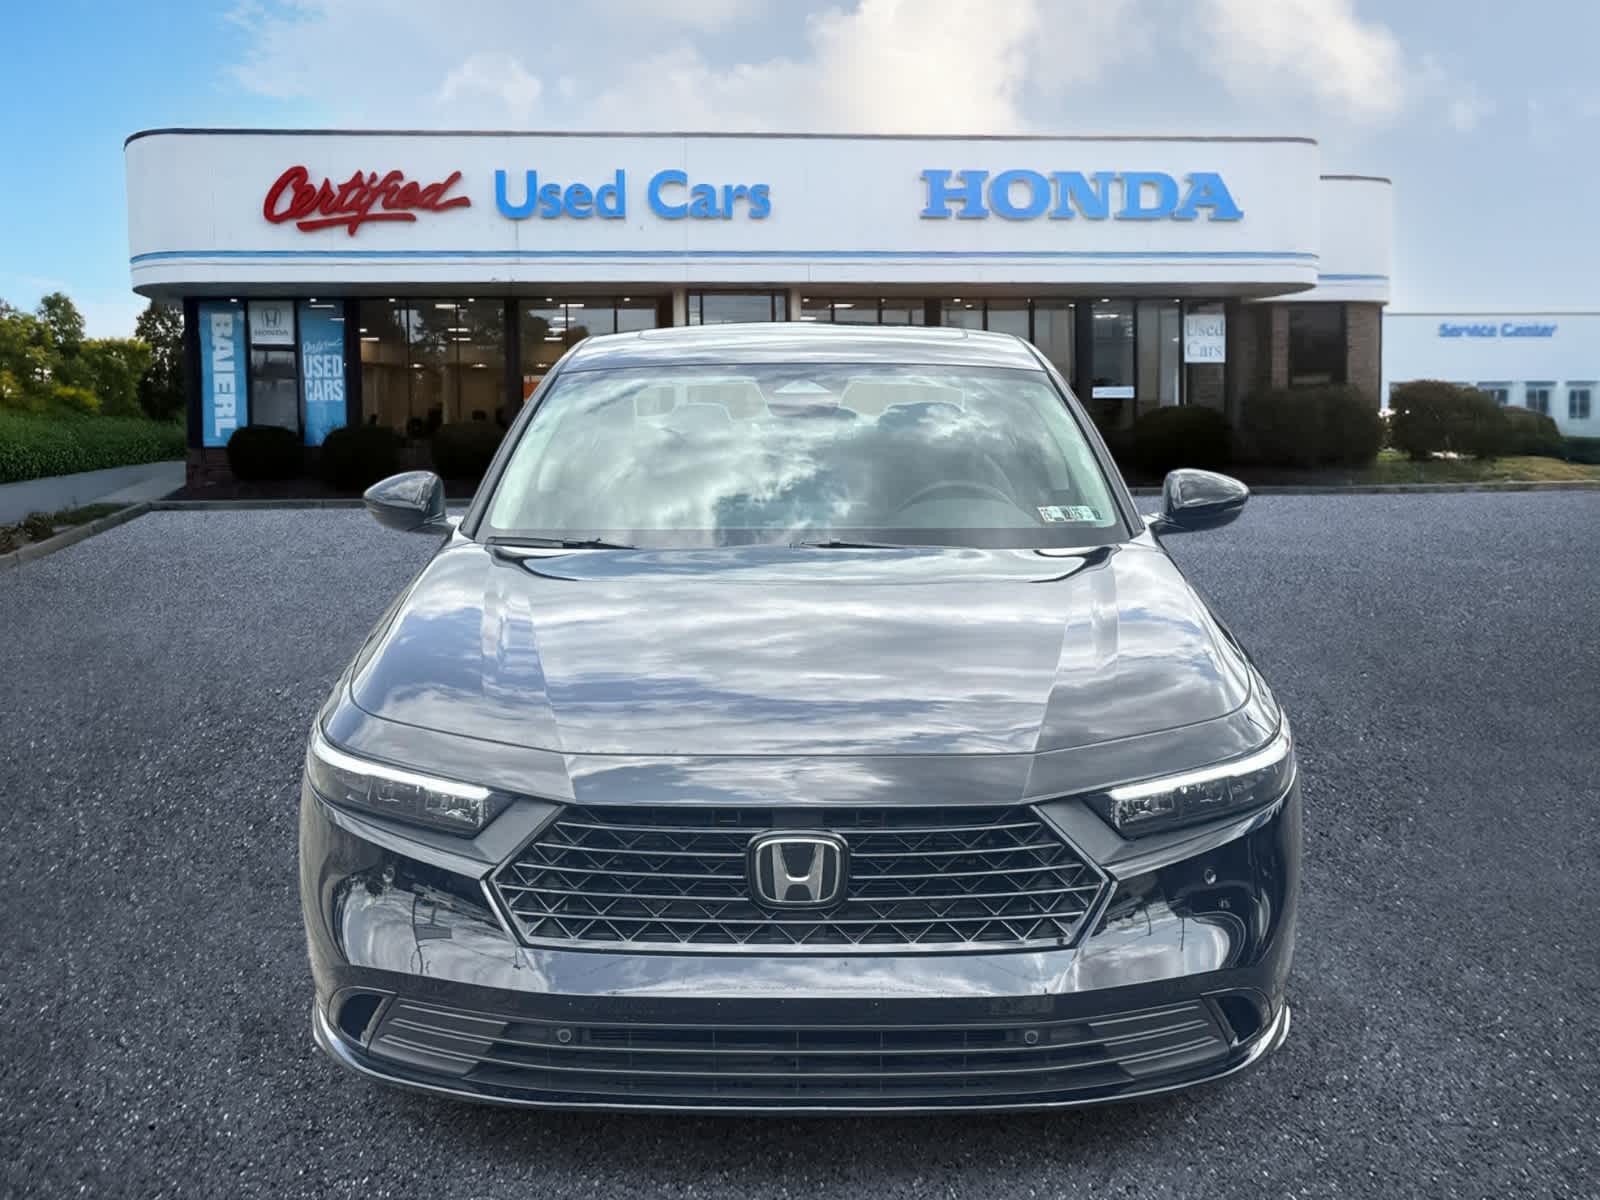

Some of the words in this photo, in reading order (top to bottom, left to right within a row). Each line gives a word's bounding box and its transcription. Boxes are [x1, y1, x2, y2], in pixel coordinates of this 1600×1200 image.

[264, 165, 471, 237] Certified
[495, 169, 625, 219] Used
[647, 169, 772, 219] Cars
[920, 169, 1244, 220] HONDA
[254, 329, 289, 337] HONDA
[1186, 318, 1224, 337] Used
[1439, 323, 1497, 338] Service
[1501, 323, 1557, 338] Center
[1186, 341, 1224, 358] Cars
[211, 313, 237, 437] BAIERL
[303, 354, 343, 378] USED
[305, 379, 343, 402] CARS
